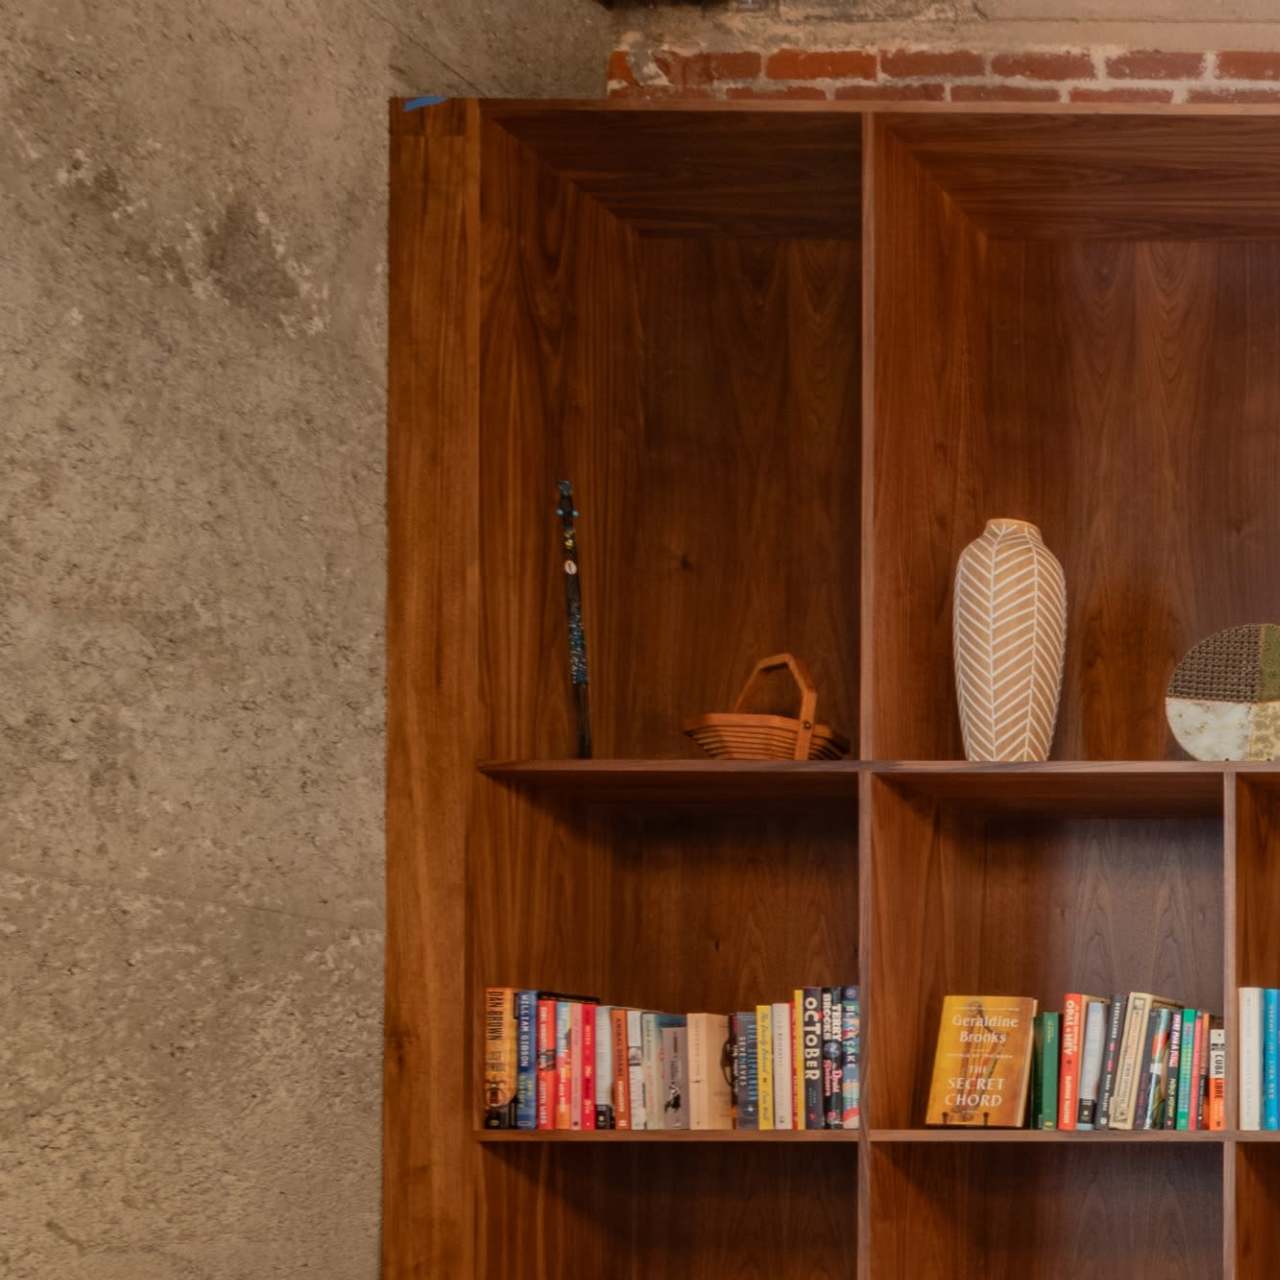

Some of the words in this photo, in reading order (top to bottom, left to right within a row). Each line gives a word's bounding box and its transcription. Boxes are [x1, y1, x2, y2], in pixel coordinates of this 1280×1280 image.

[487, 991, 504, 1008] DAN
[520, 995, 530, 1031] WILLIAM
[823, 993, 832, 1040] BROOKS
[832, 1004, 842, 1041] TERRY
[952, 1014, 1019, 1028] Geraldine
[487, 1010, 504, 1041] BROWN
[960, 1030, 1008, 1044] Brooks
[520, 1035, 530, 1067] GIBSON
[803, 997, 822, 1081] OCTOBER
[846, 1040, 856, 1068] CAKE
[1214, 1054, 1225, 1075] CUBA
[947, 1077, 1007, 1091] SECRET
[1214, 1078, 1225, 1099] LIBRE
[944, 1093, 1003, 1107] CHORD
